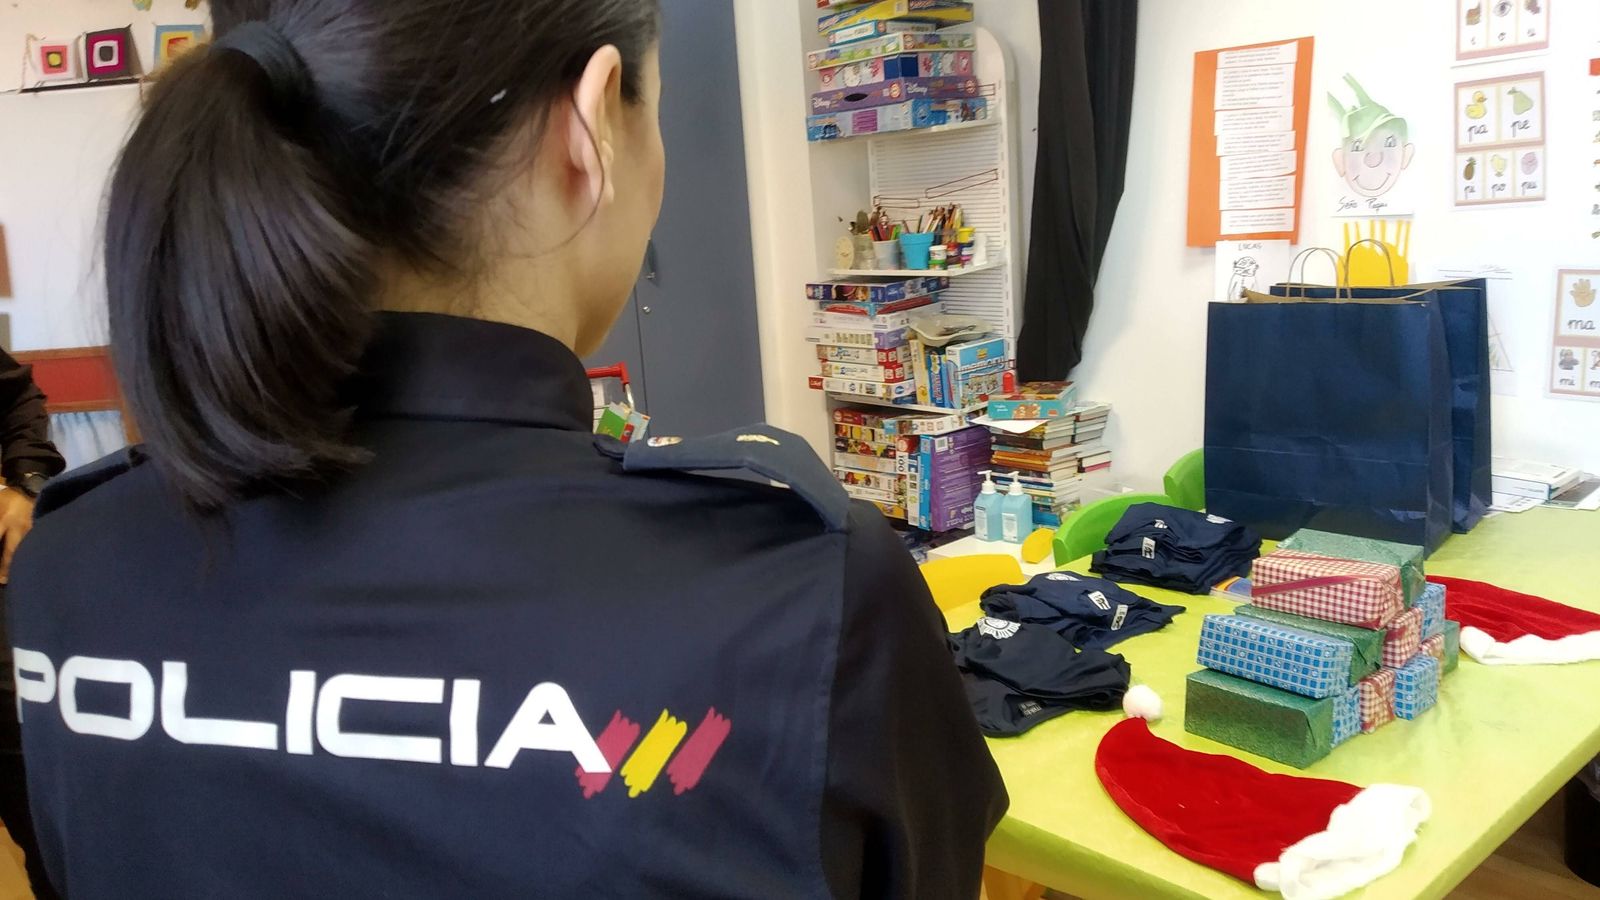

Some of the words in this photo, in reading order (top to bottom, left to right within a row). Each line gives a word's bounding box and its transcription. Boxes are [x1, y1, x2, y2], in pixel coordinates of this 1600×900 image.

[1467, 124, 1488, 143] pa
[1511, 120, 1530, 138] pe
[1567, 320, 1596, 330] ma
[13, 647, 613, 774] POLICIA
